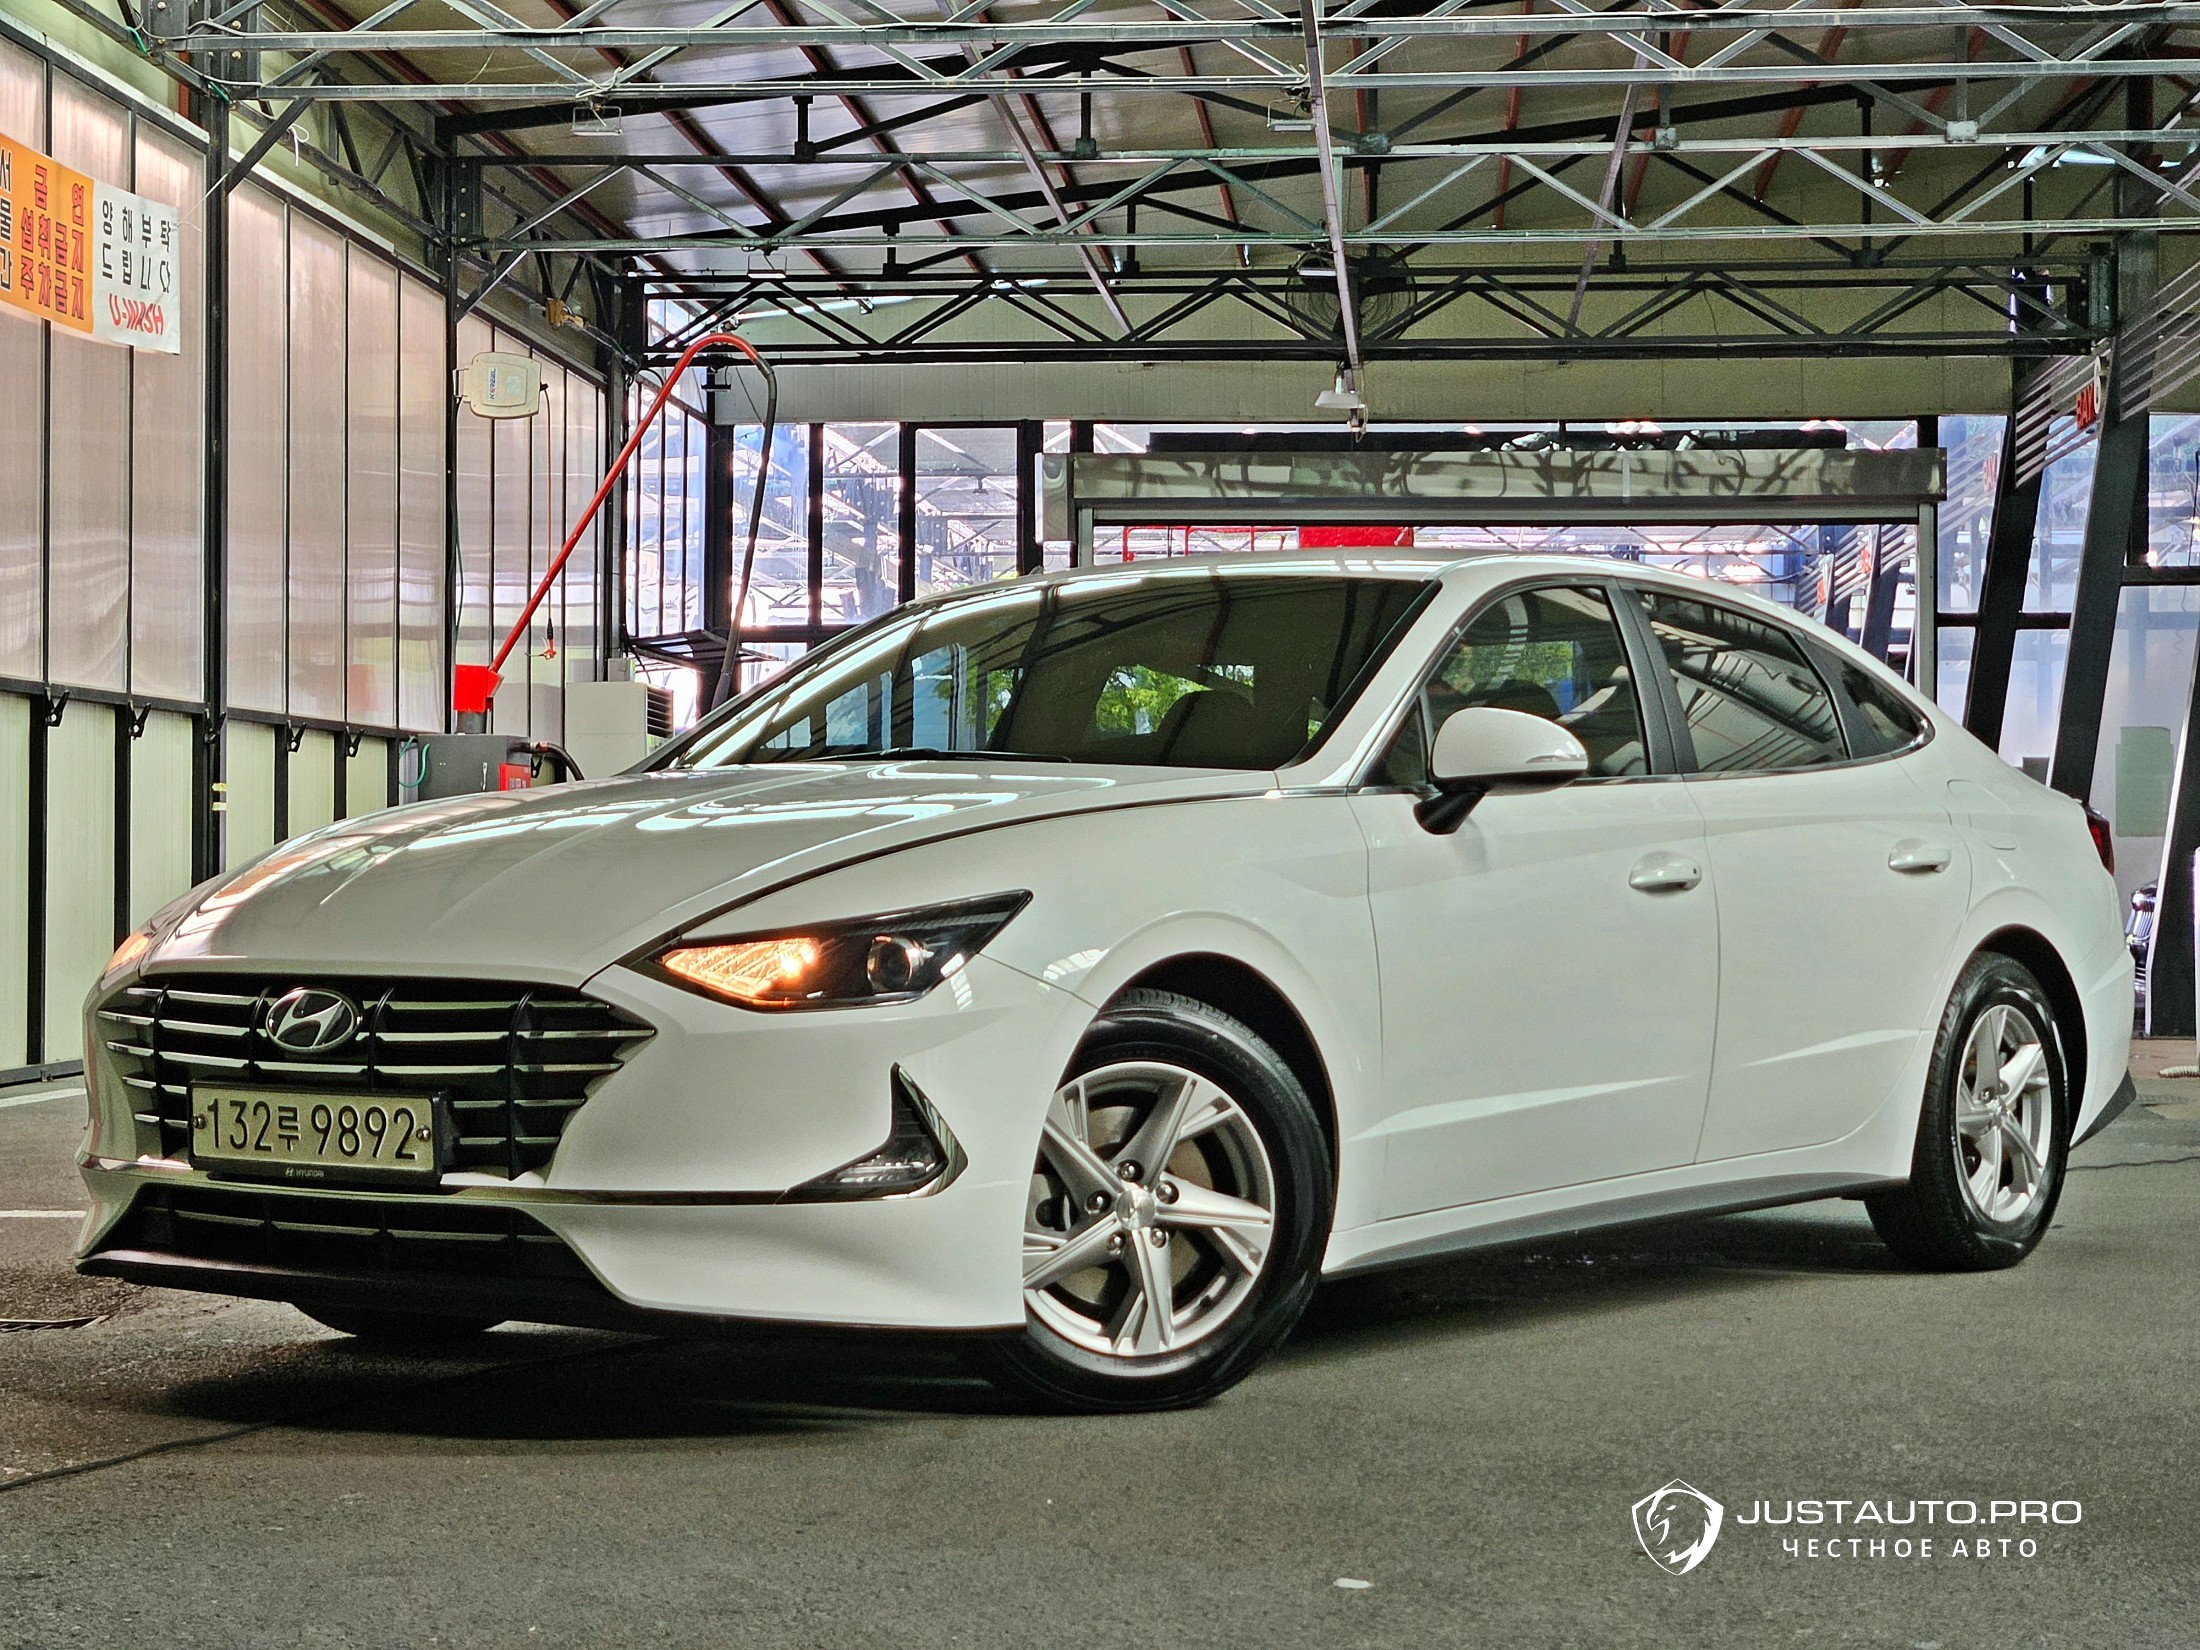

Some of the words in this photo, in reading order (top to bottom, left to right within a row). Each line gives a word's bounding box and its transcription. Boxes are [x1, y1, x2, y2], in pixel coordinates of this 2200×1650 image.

[20, 207, 84, 273] 섭취금지
[102, 243, 170, 293] 드립니다
[20, 255, 84, 320] 주차금지
[109, 293, 164, 335] U-WASH
[207, 1098, 299, 1151] 132루
[311, 1104, 415, 1160] 9892
